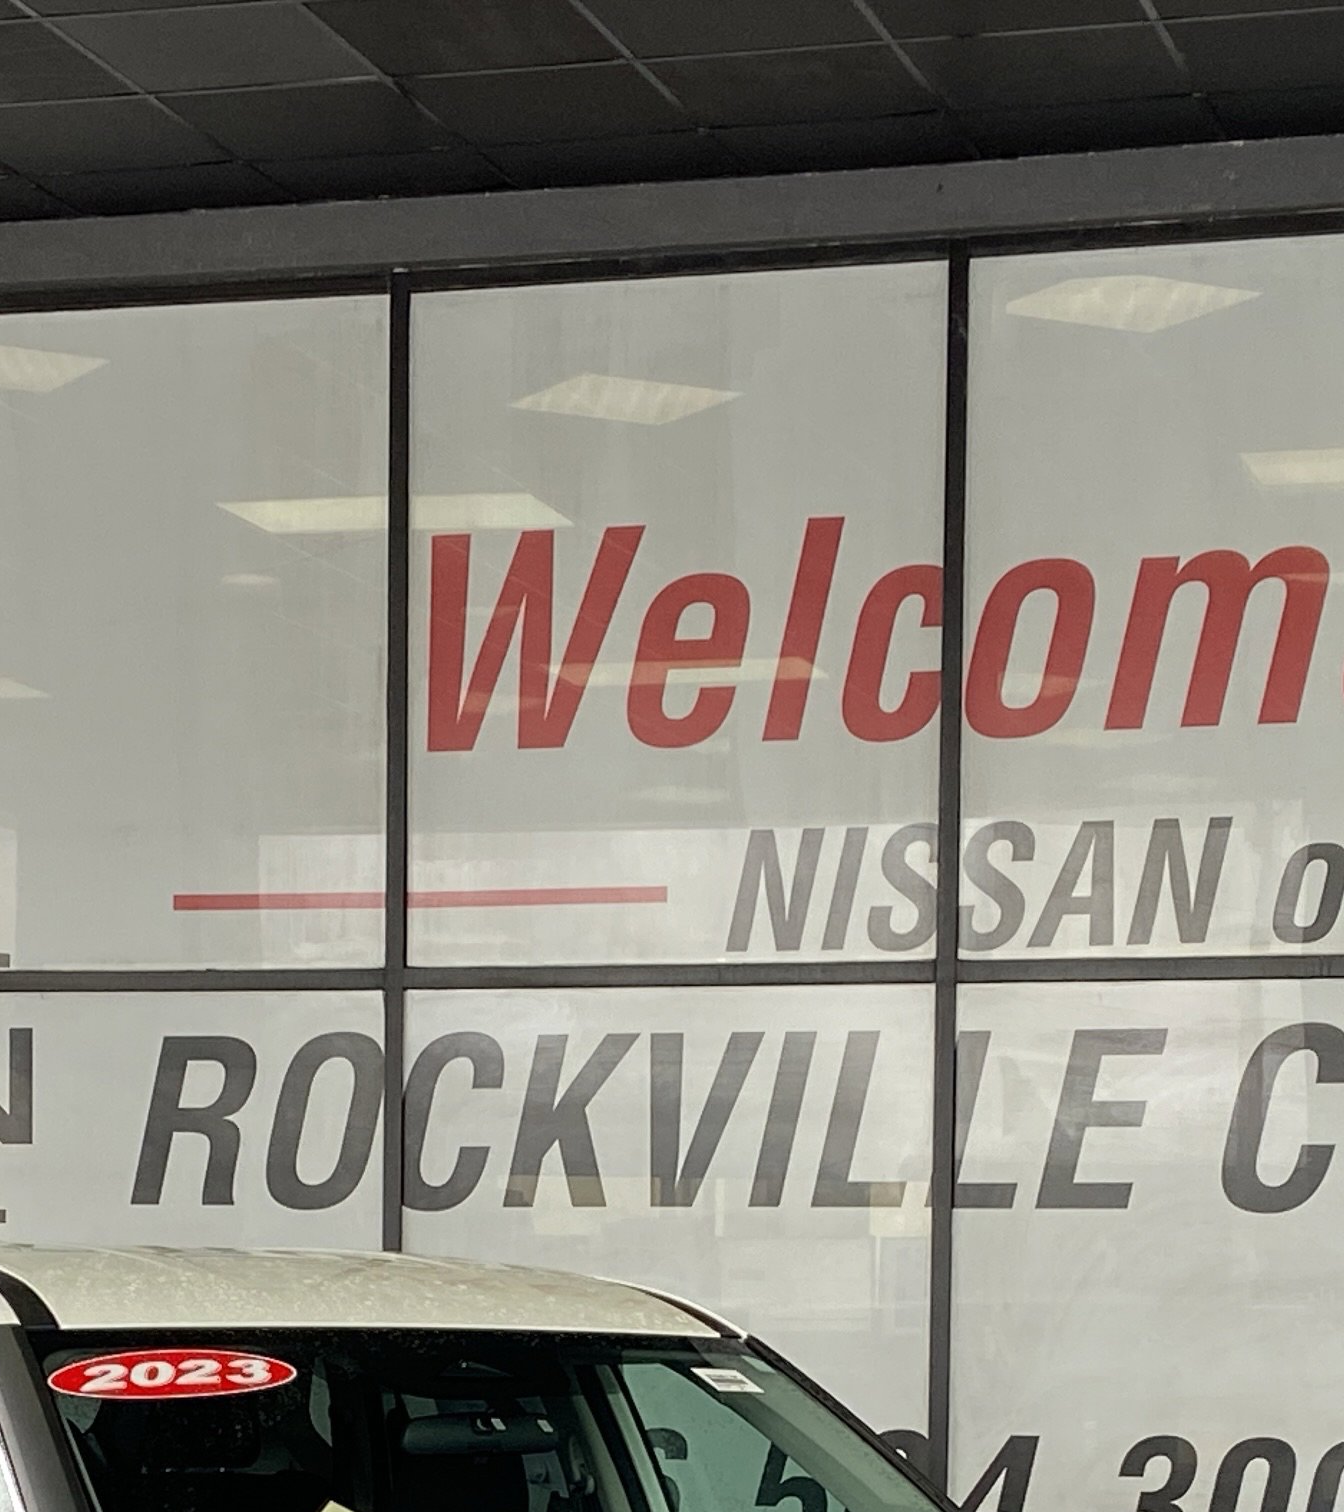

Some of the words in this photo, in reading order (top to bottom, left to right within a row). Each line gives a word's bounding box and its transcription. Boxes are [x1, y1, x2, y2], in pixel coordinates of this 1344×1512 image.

[725, 815, 1233, 952] NISSAN
[129, 1028, 1169, 1211] ROCKVILLE
[80, 1359, 272, 1392] 2023
